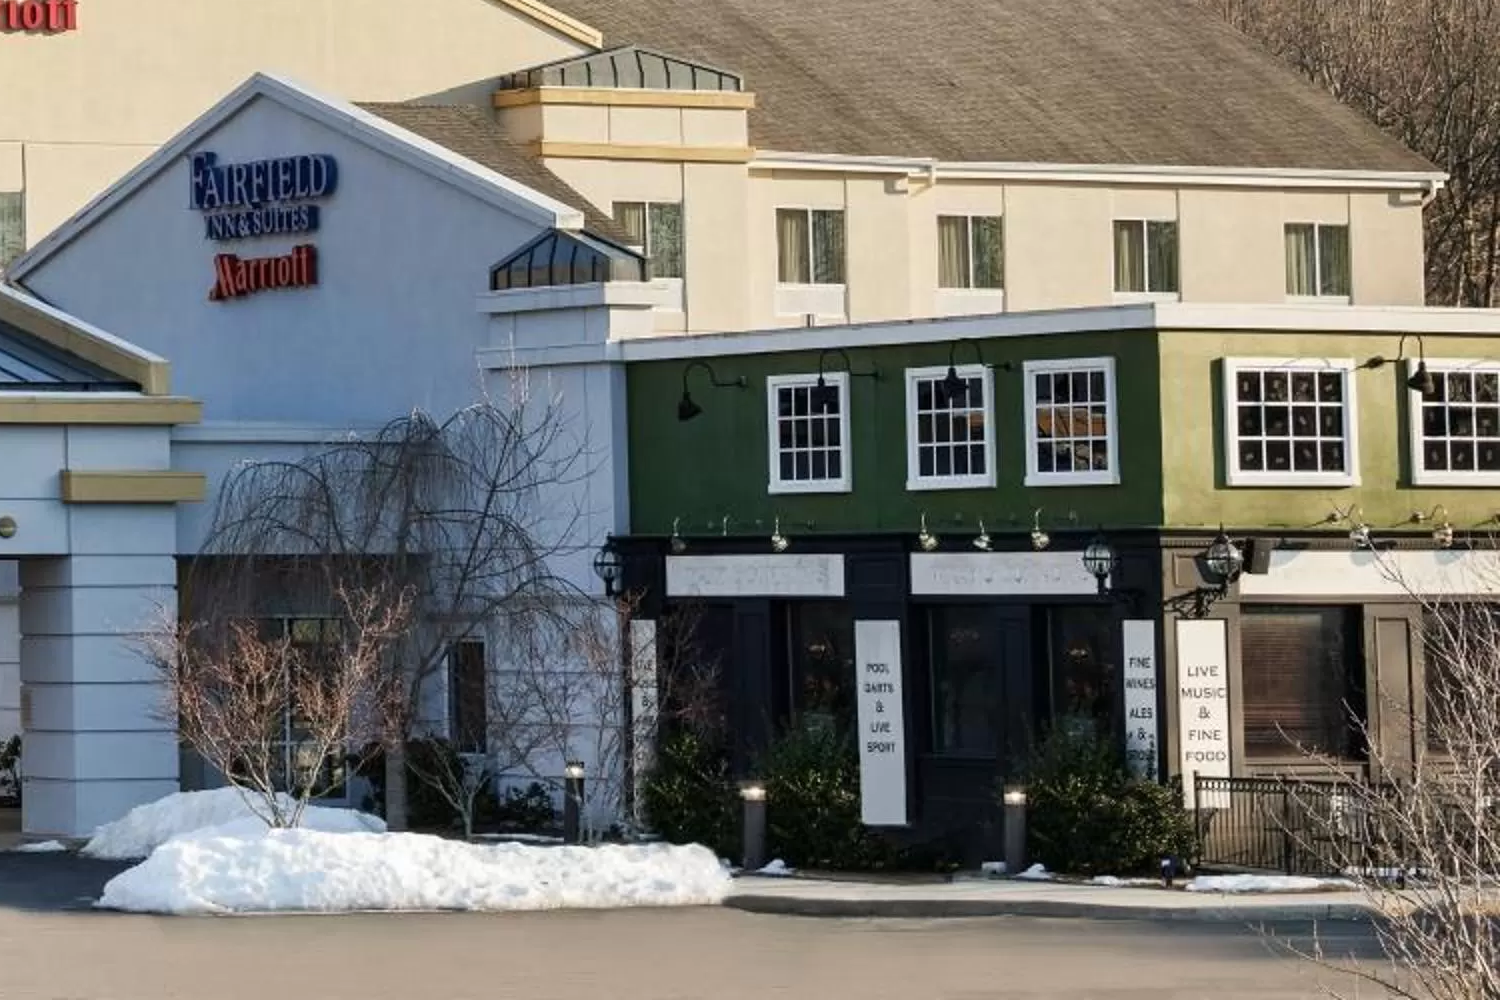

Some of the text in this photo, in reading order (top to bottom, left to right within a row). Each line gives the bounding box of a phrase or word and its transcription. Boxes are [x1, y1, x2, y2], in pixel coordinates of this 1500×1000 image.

[189, 152, 336, 210] FAIRFIELD
[203, 205, 316, 240] INN & SUITES
[209, 245, 316, 301] Marriott
[866, 663, 890, 674] POOL
[1128, 657, 1151, 668] FINE
[1187, 665, 1219, 677] LIVE
[1126, 678, 1156, 689] WINES
[1181, 687, 1227, 698] MUSIC
[875, 700, 884, 713] &
[1198, 706, 1211, 719] &
[1129, 707, 1152, 719] ALES
[1137, 727, 1147, 740] &
[1189, 729, 1222, 741] FINE
[867, 742, 896, 753] SPORT
[1185, 751, 1227, 762] FOOD
